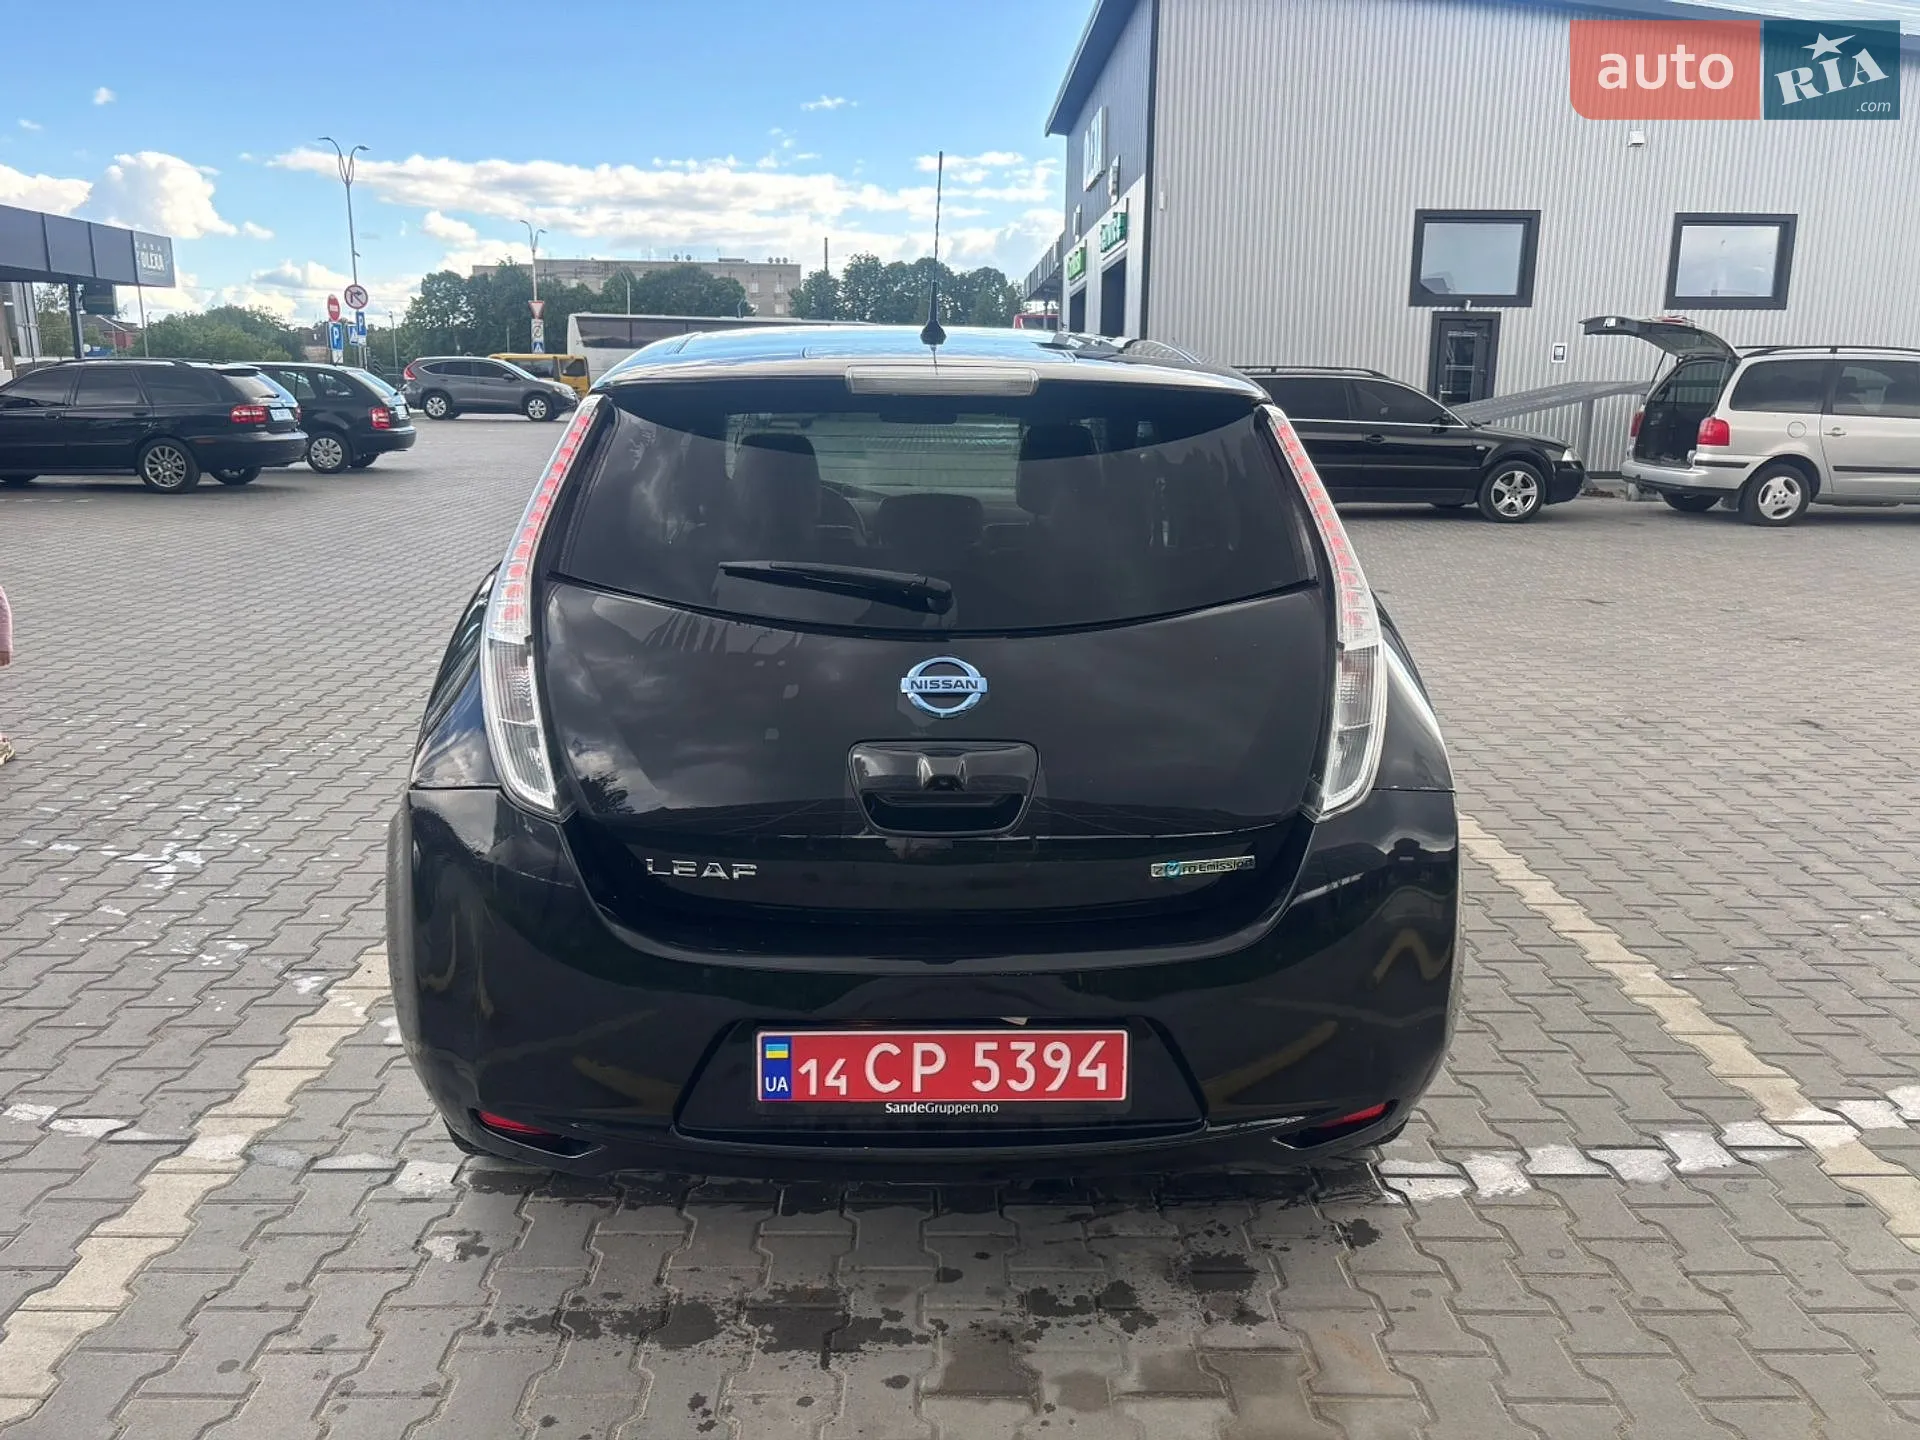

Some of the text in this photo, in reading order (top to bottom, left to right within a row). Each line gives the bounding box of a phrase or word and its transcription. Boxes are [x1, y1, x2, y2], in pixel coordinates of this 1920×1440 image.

[910, 679, 979, 691] NISSAN
[646, 858, 758, 880] LEAF
[798, 1040, 1107, 1096] 14 CP 5394
[765, 1076, 789, 1092] UA
[885, 1101, 999, 1115] SandeGruppen.no
